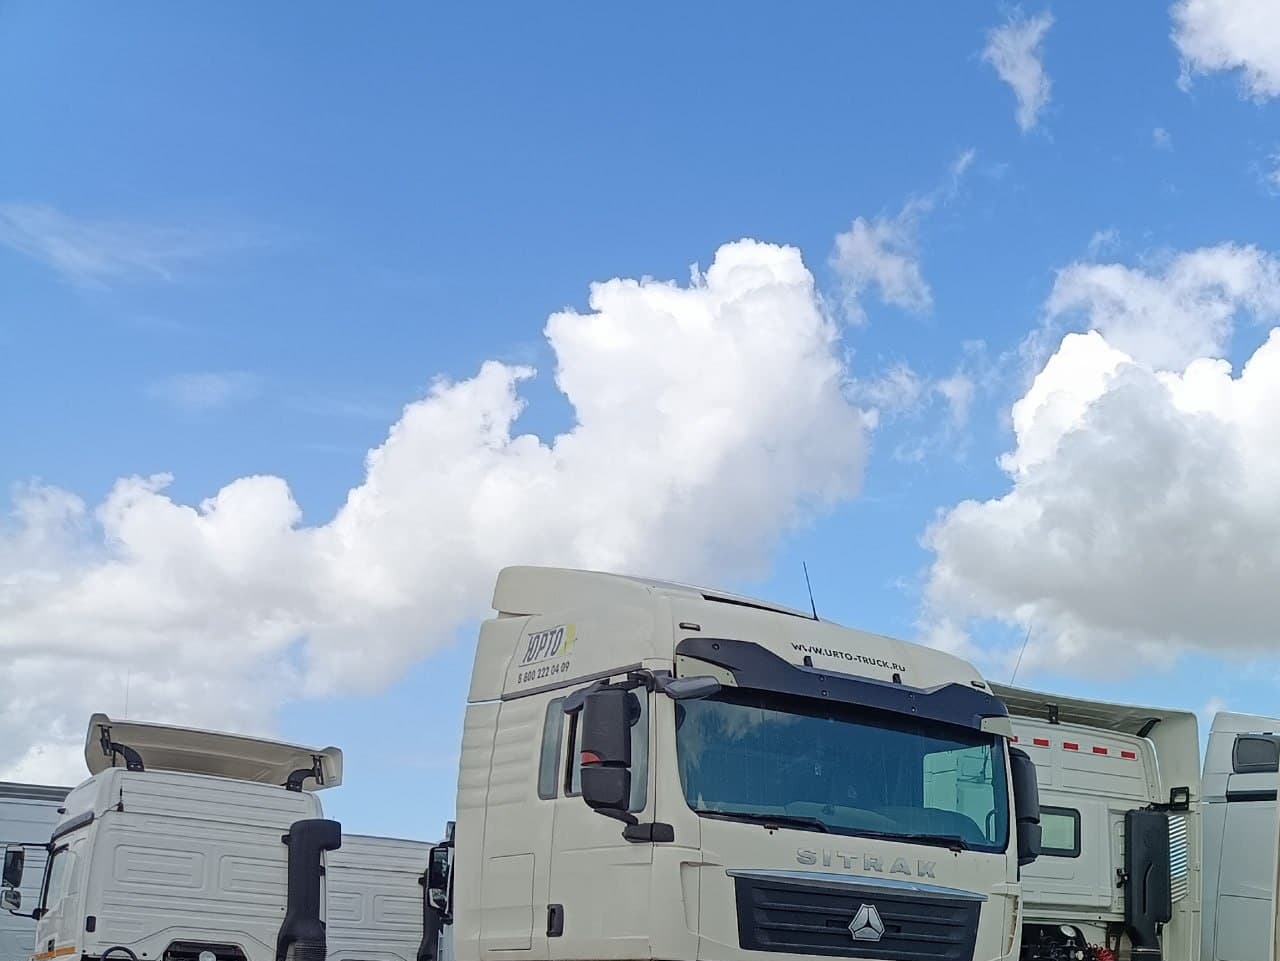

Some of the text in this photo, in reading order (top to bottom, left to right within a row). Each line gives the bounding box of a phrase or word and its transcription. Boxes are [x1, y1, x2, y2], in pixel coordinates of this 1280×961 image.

[517, 661, 570, 684] 8 800 222 04 09
[796, 847, 937, 878] SITRAK
